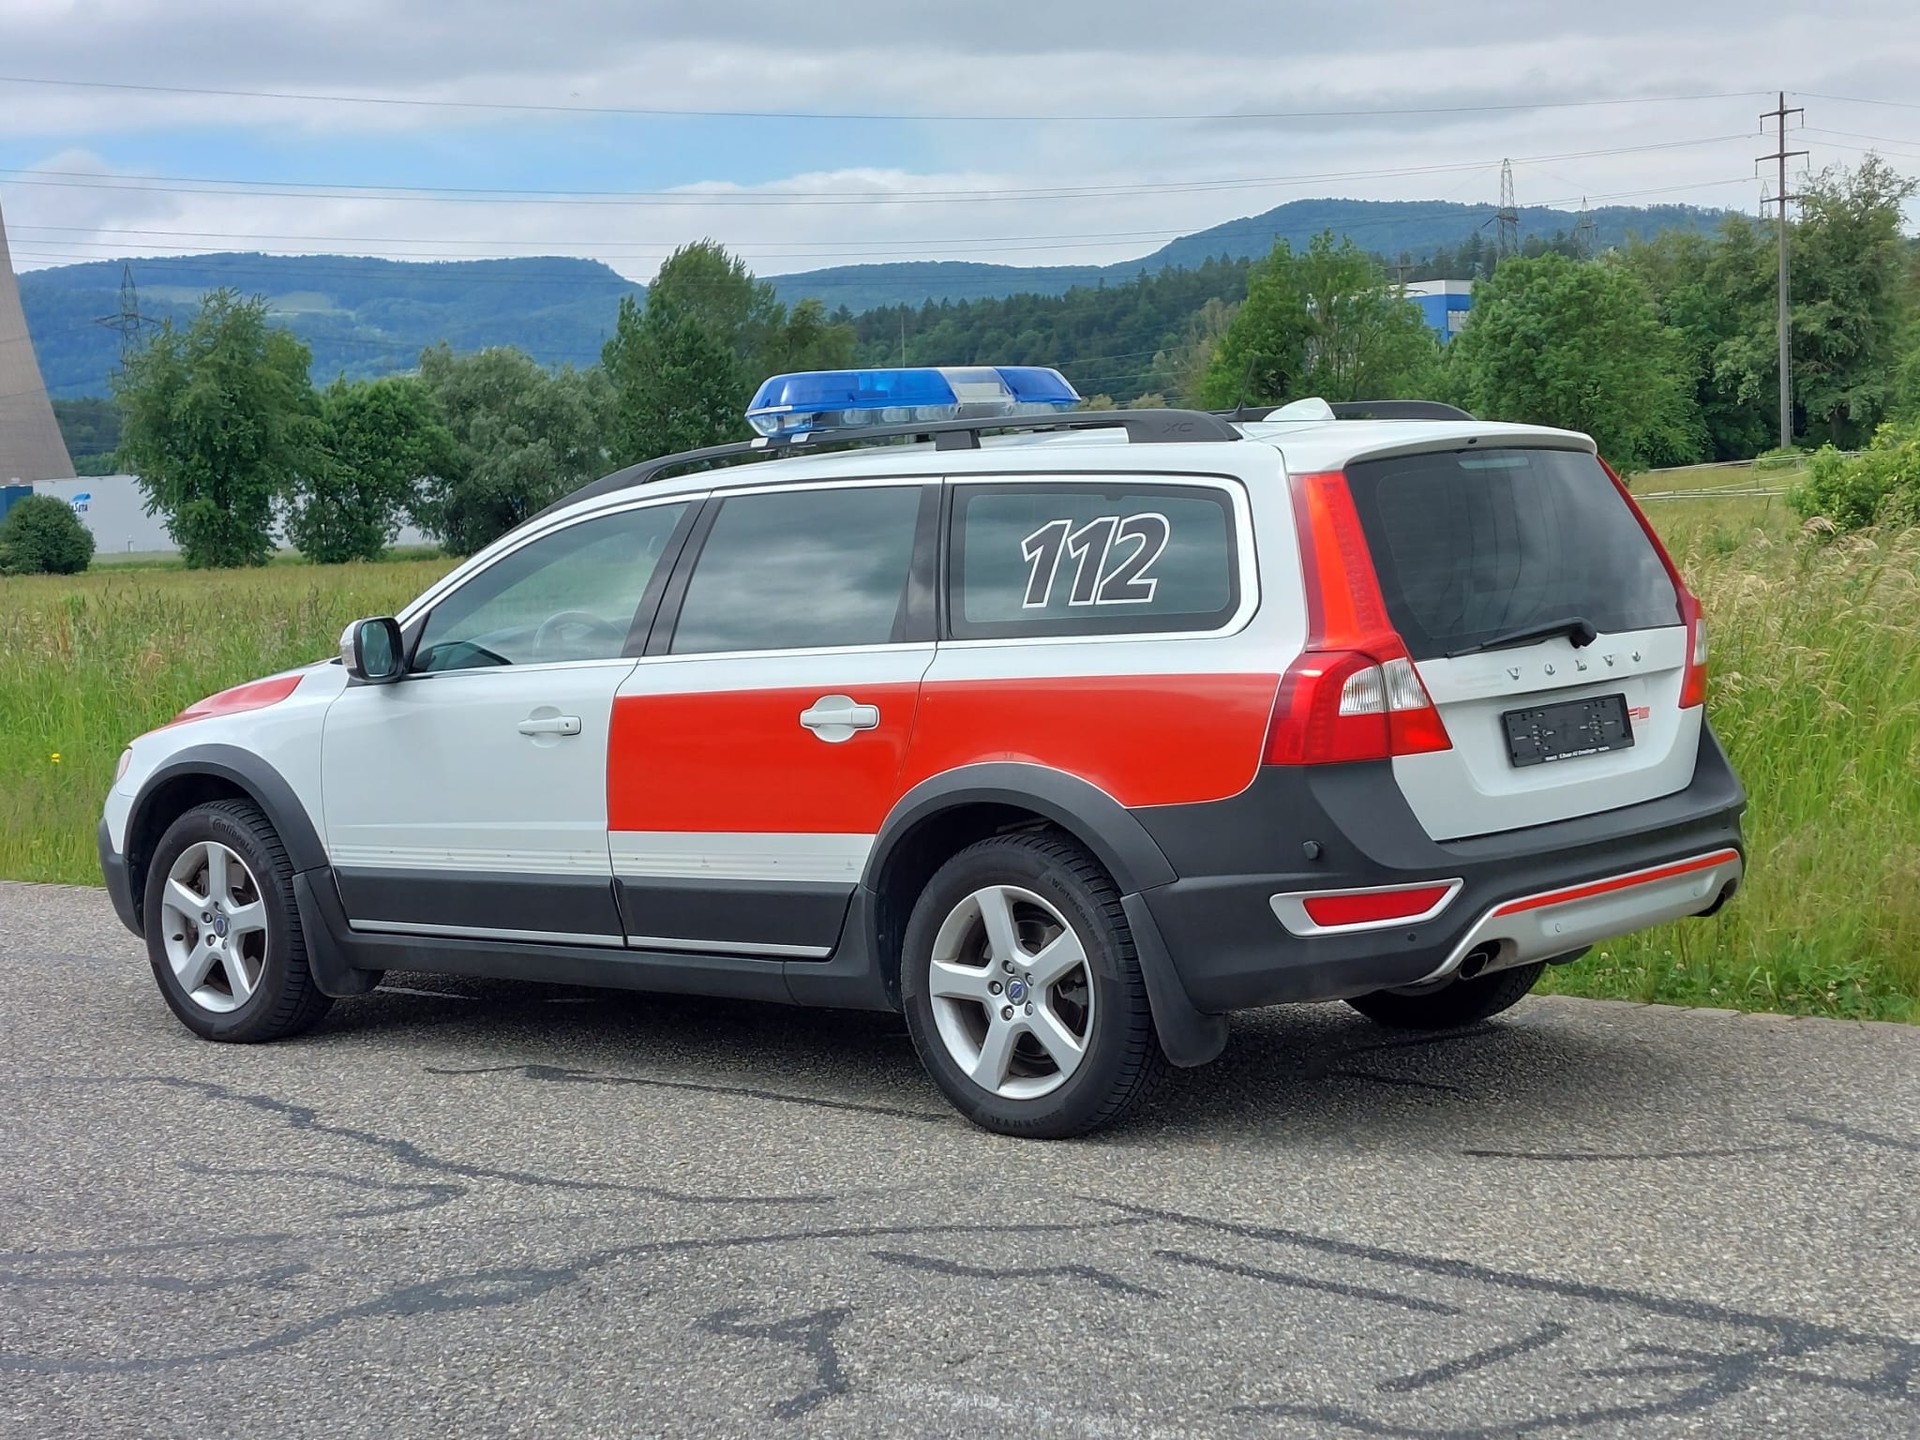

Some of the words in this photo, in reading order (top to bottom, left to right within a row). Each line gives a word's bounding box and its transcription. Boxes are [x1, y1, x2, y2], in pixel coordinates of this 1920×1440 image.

[1162, 421, 1192, 434] XC
[1020, 512, 1171, 609] 112
[1506, 650, 1641, 681] VOLVO
